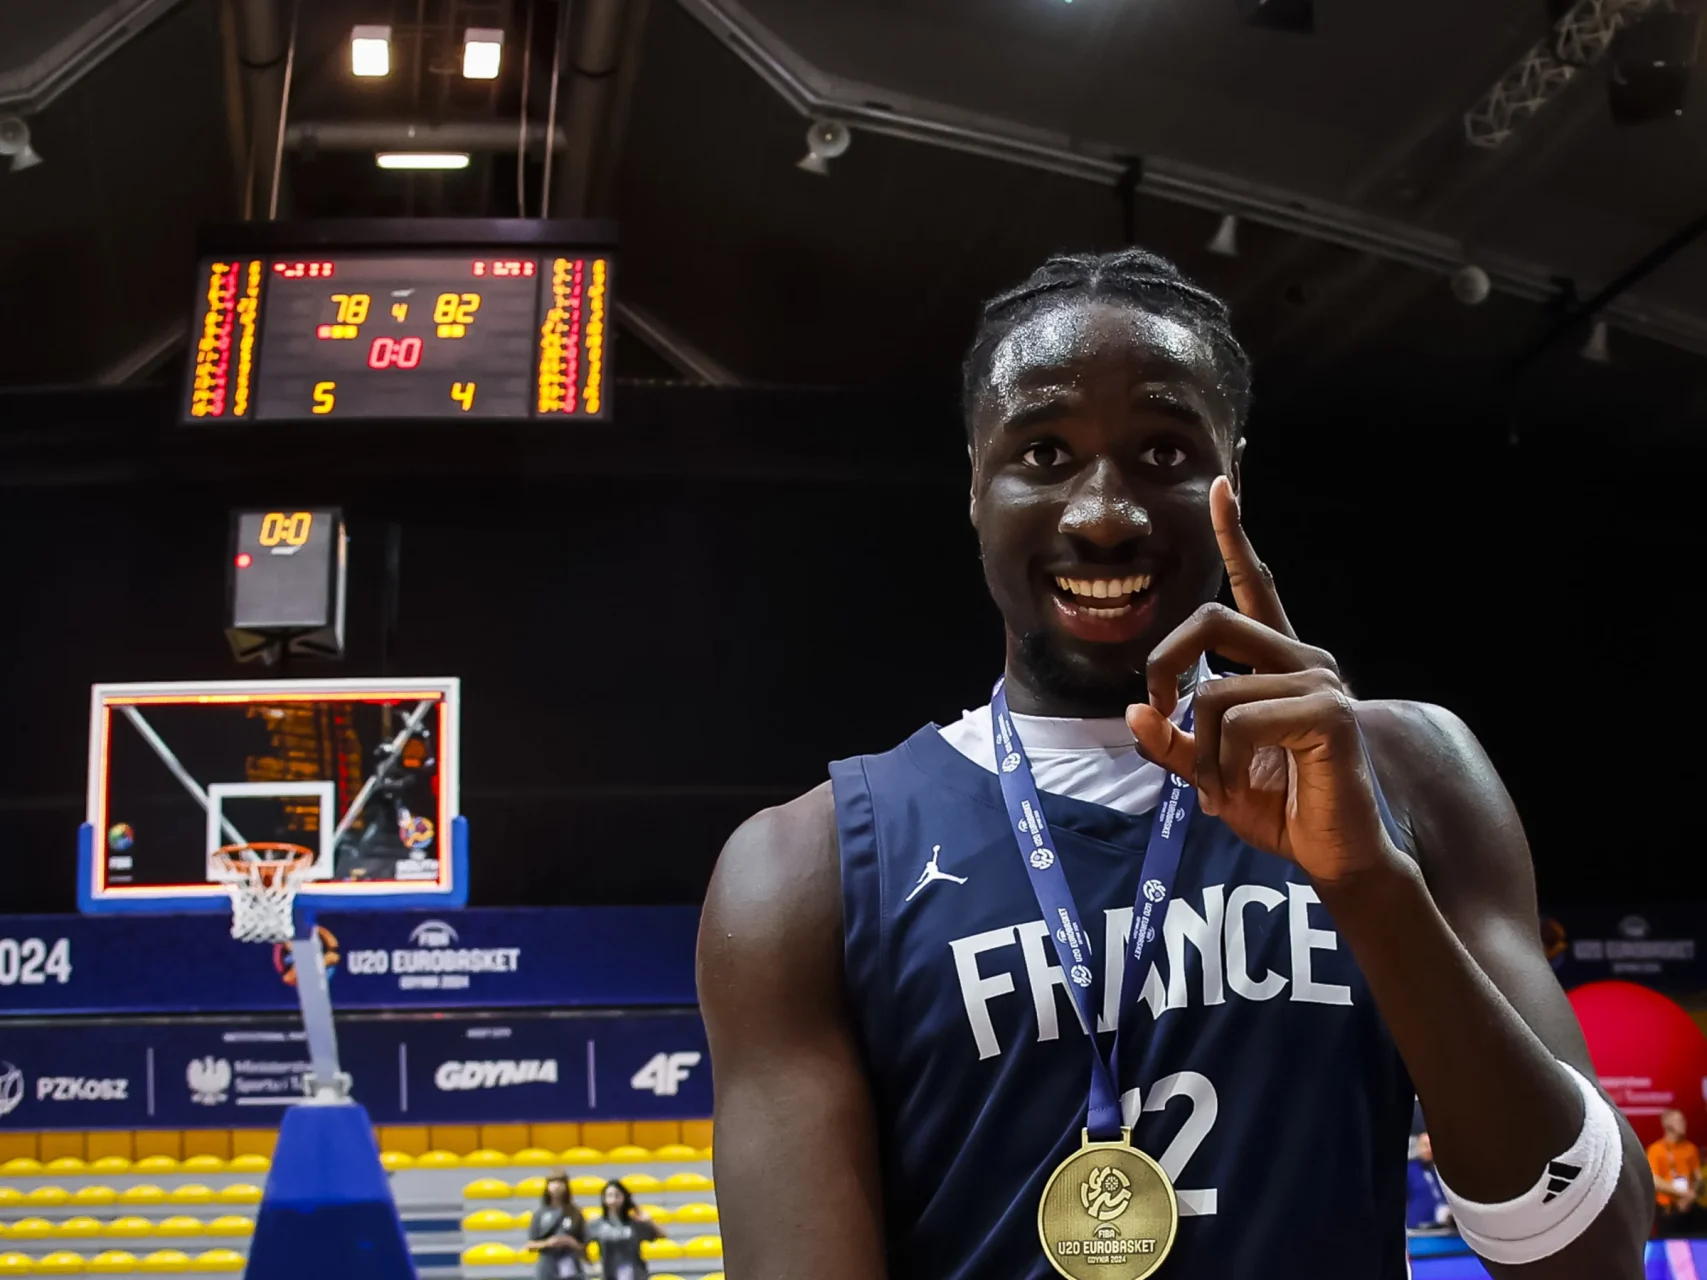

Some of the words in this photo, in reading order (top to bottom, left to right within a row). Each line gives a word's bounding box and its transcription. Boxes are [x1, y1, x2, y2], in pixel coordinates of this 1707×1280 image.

[331, 294, 371, 324] 78
[391, 303, 409, 323] 4
[434, 293, 481, 323] 82
[312, 382, 336, 414] 5
[451, 382, 476, 412] 4
[0, 937, 72, 985] 024
[347, 950, 390, 974] U20
[949, 882, 1353, 1060] FRANCE
[434, 1059, 558, 1091] GDYNIA
[630, 1052, 701, 1095] 4F
[1058, 1241, 1080, 1255] U20
[1083, 1240, 1156, 1255] EUROBASKET
[1098, 1229, 1116, 1239] FIBA
